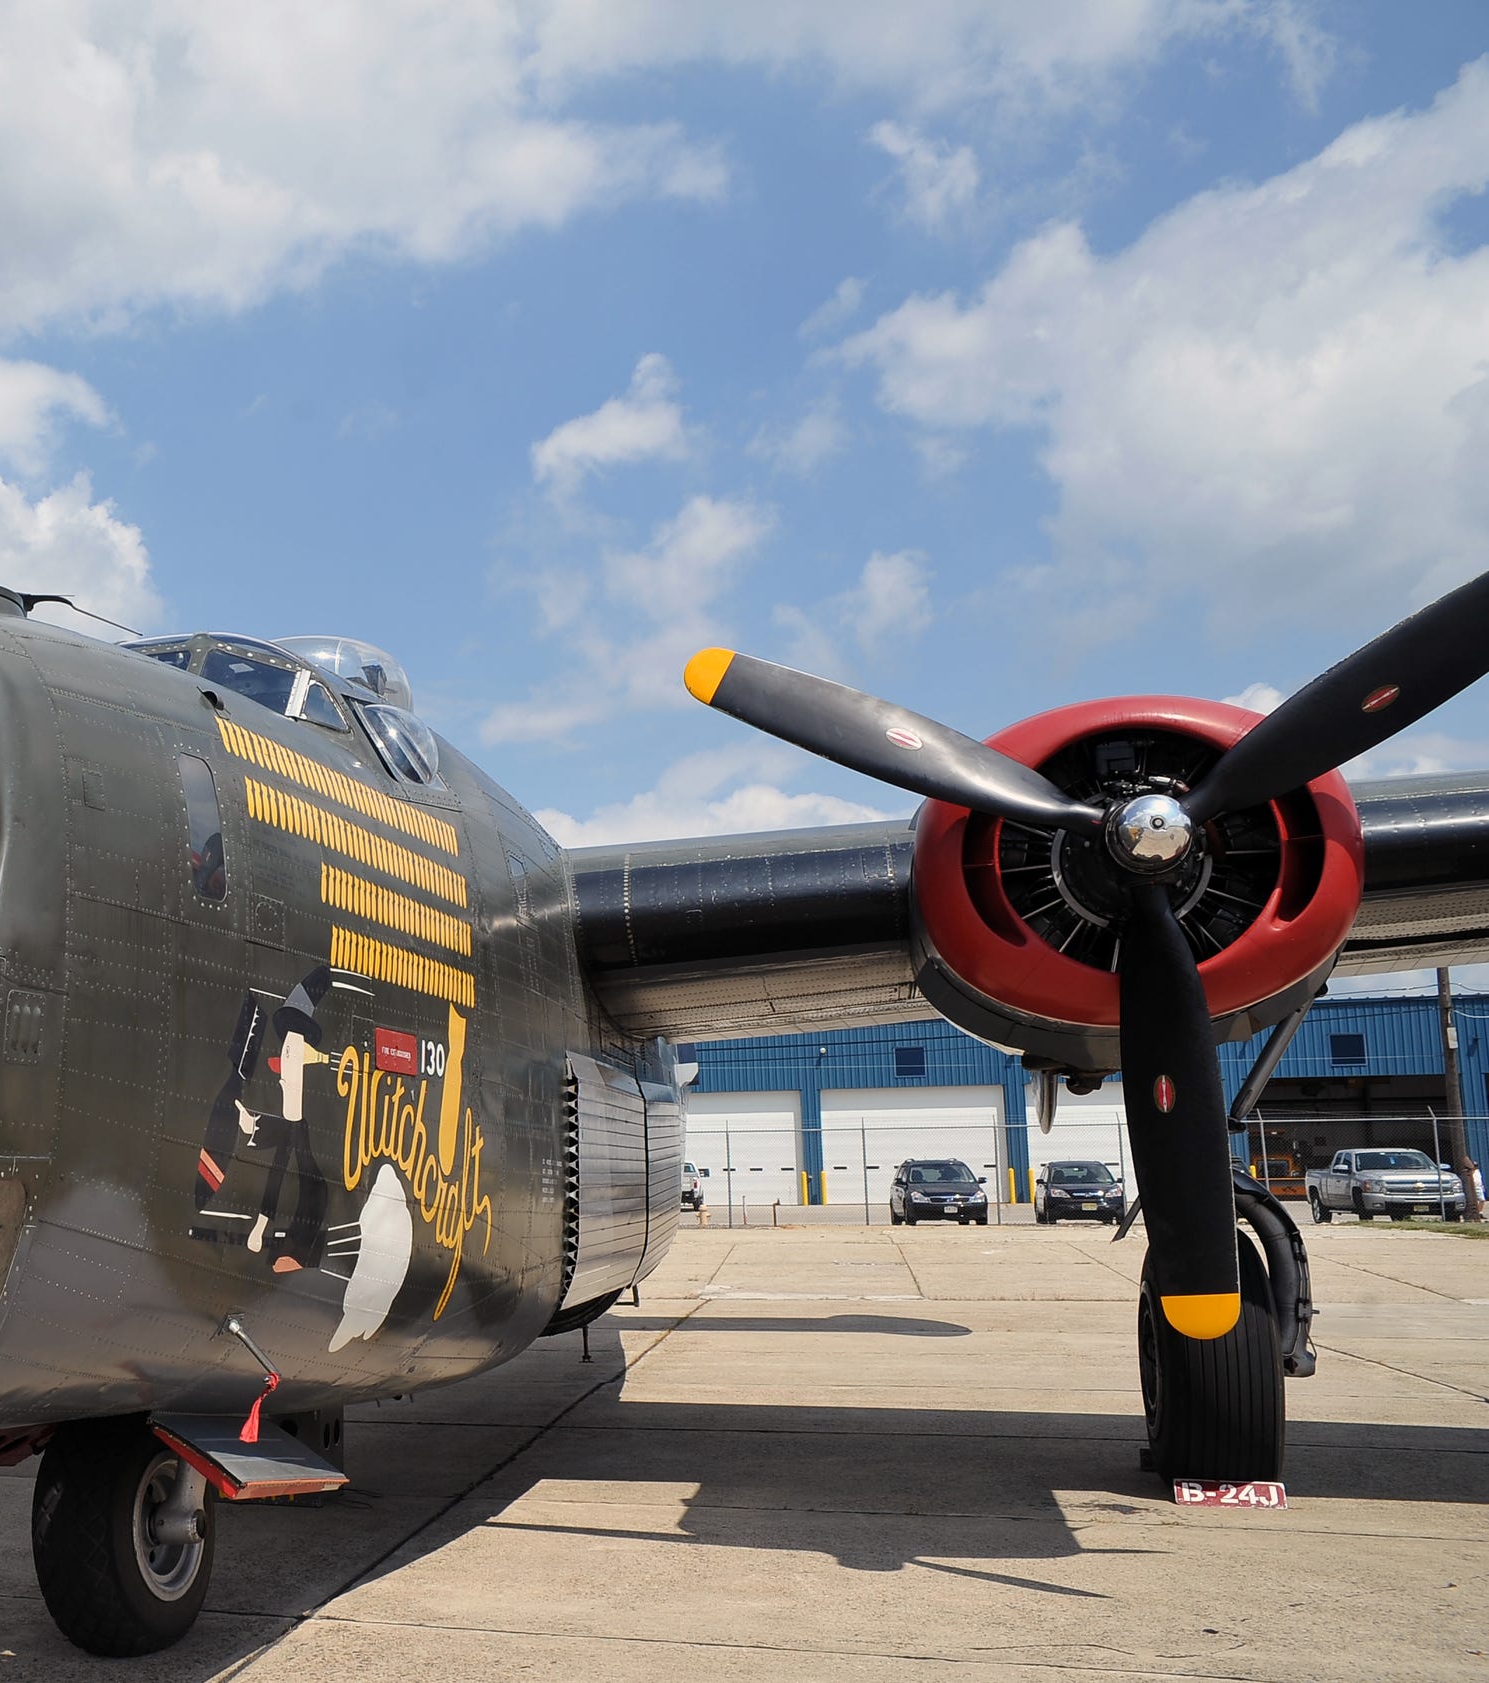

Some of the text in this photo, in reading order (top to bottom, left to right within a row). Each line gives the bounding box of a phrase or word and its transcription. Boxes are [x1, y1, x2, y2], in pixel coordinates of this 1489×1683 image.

[421, 1039, 445, 1077] 130
[336, 1045, 493, 1322] Witchcraft
[1181, 1482, 1279, 1506] B-24J
